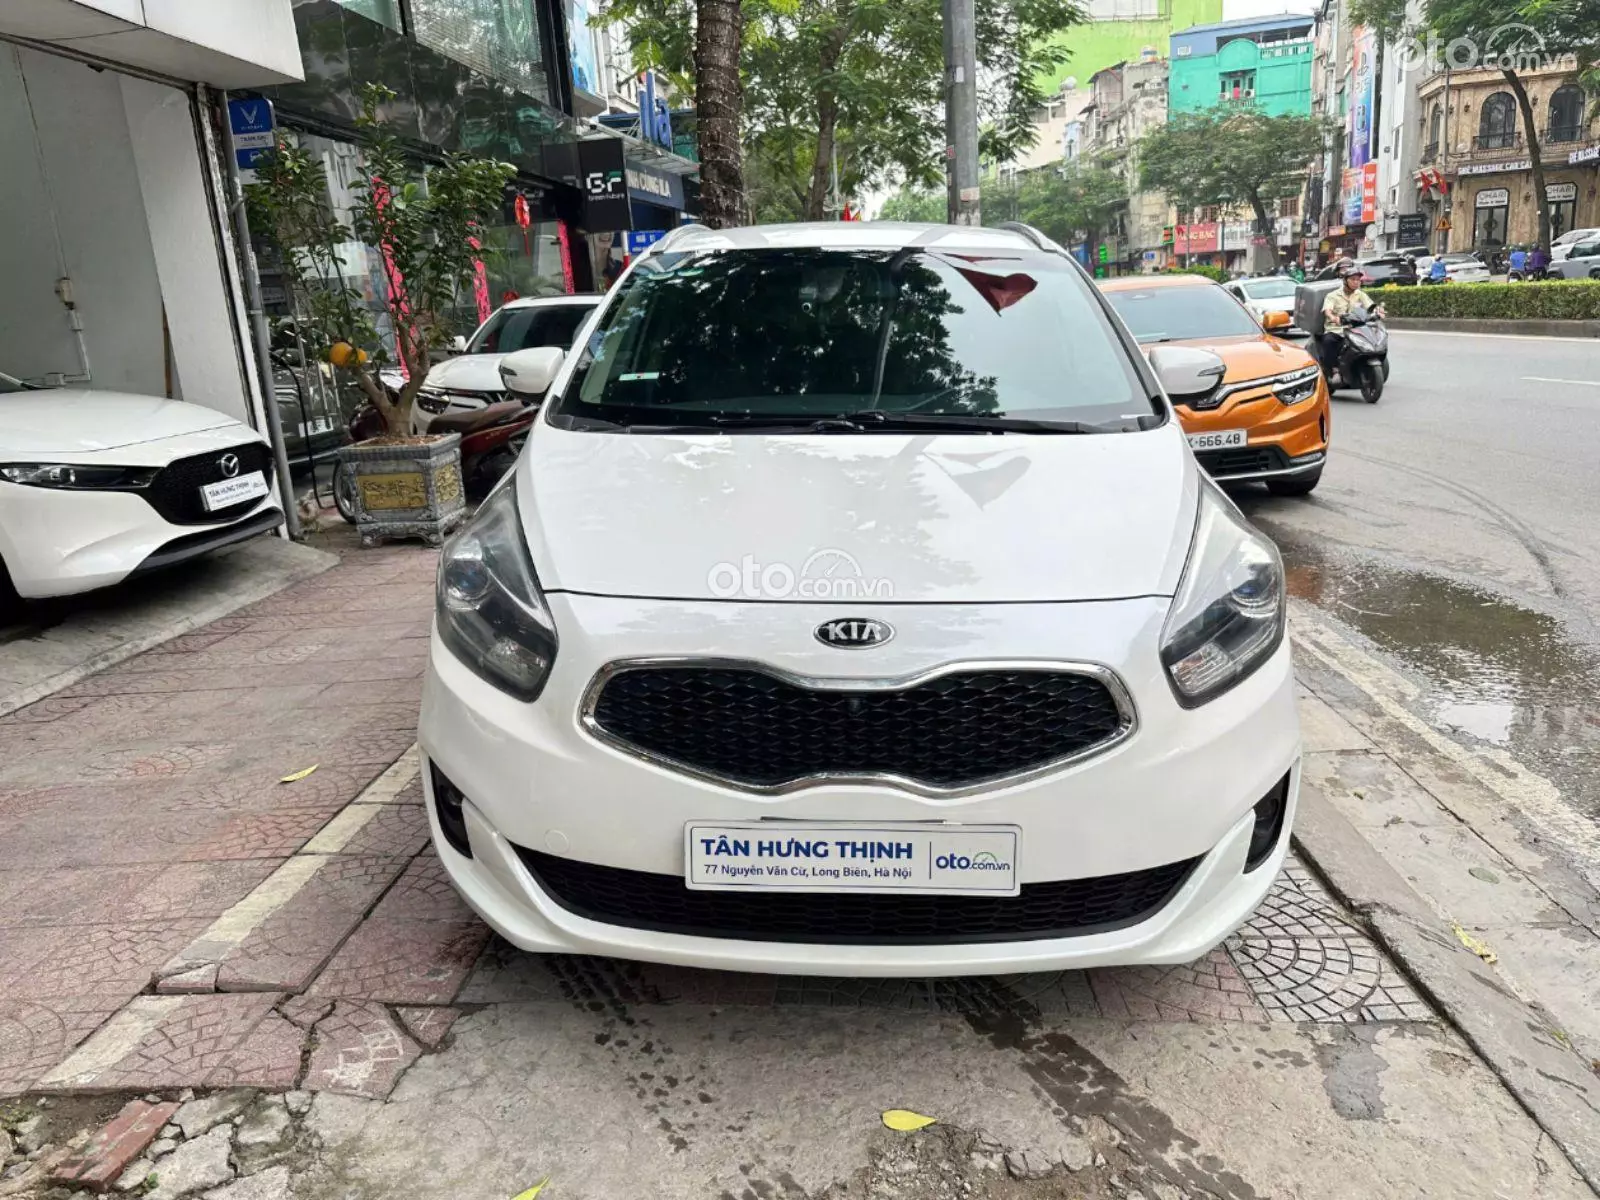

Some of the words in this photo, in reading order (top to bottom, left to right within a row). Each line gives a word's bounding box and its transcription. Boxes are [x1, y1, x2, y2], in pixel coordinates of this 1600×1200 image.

[828, 621, 882, 641] KIA
[700, 834, 750, 857] TÂN
[758, 837, 829, 858] HƯNG
[835, 841, 913, 863] THỊNH
[704, 864, 717, 874] 77
[766, 866, 788, 876] Văn
[812, 867, 840, 879] Long
[843, 867, 871, 878] Biên,
[874, 868, 890, 877] Hà
[893, 868, 912, 879] Nội
[936, 853, 1010, 871] oto.com.vn
